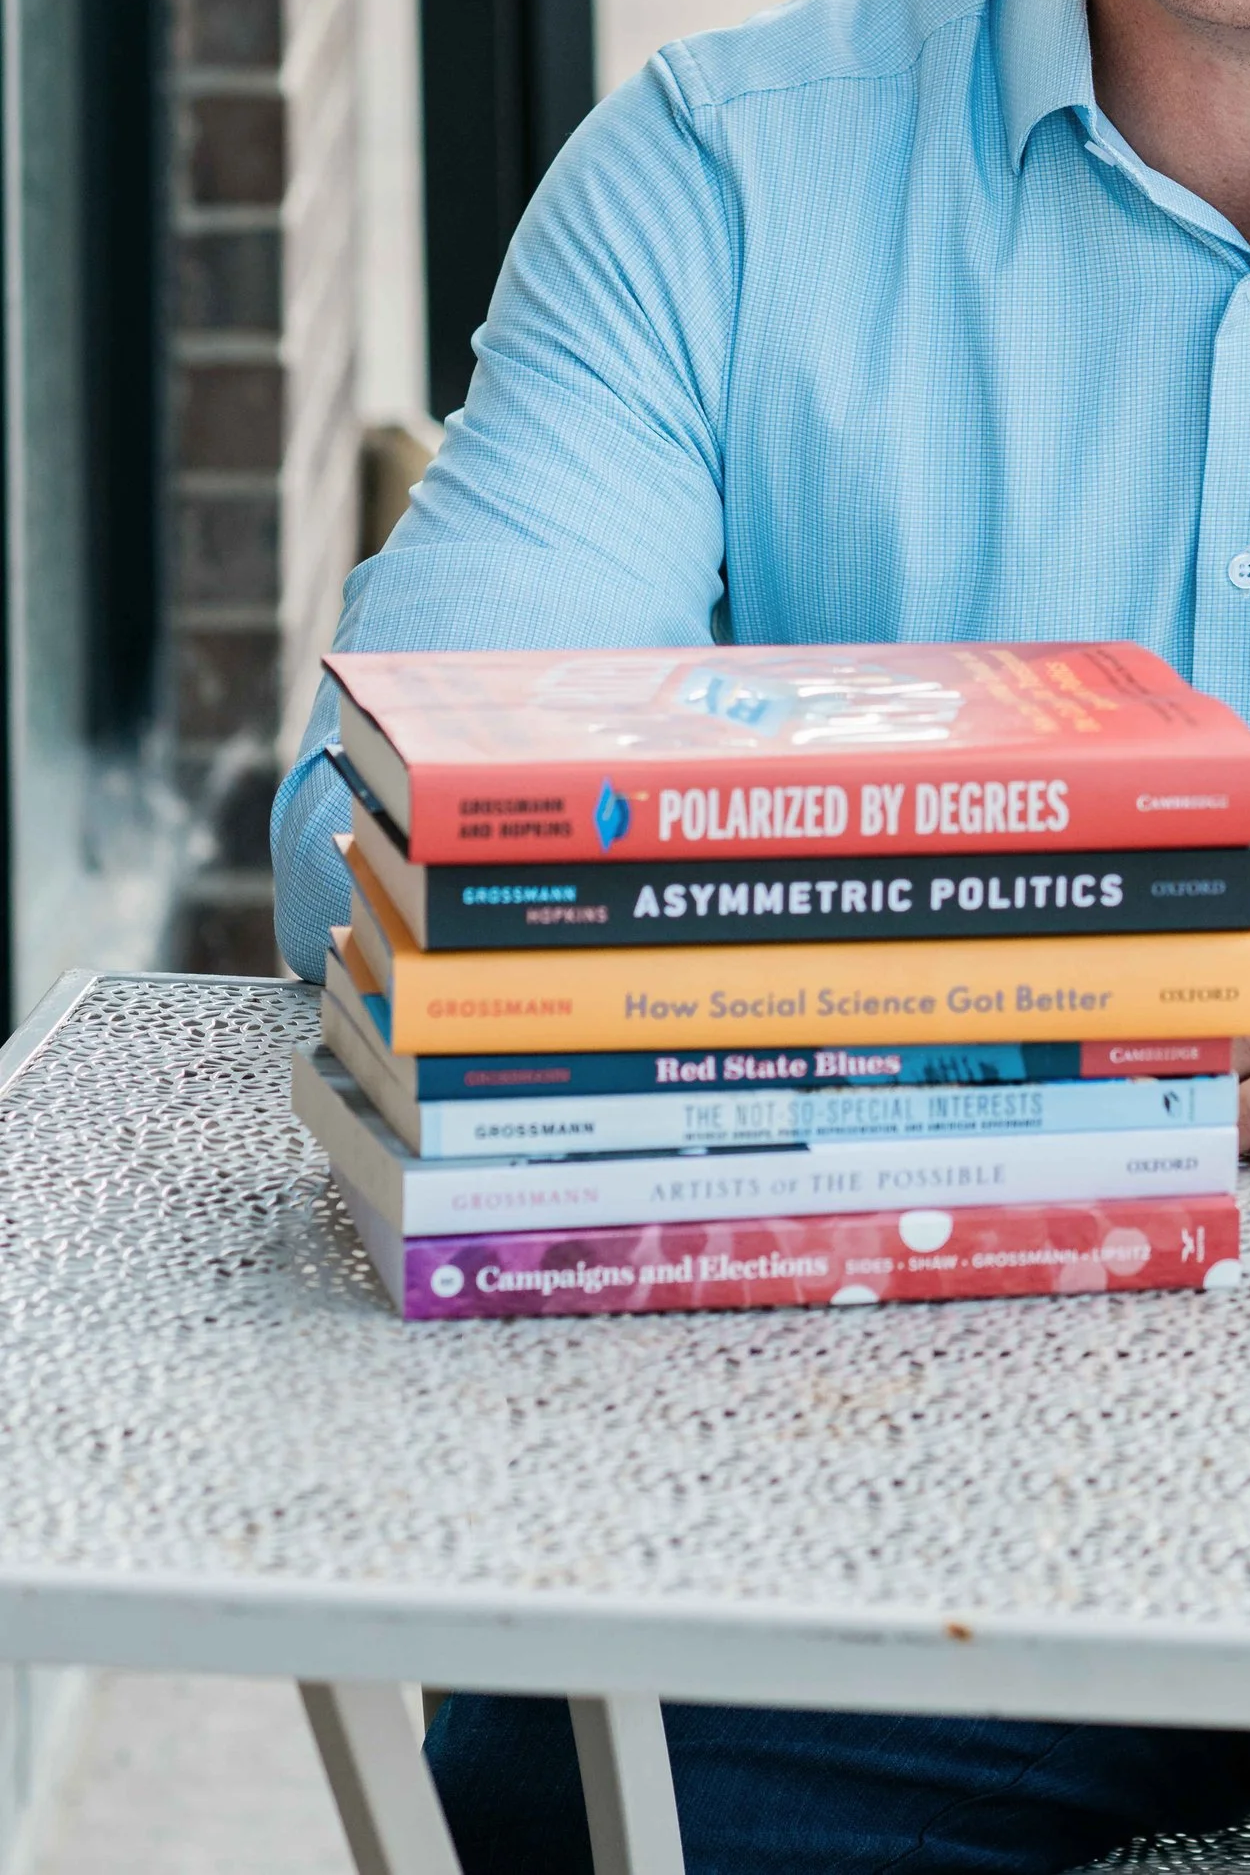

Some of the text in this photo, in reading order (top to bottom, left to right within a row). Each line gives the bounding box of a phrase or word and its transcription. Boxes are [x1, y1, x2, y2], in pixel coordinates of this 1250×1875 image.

[458, 798, 564, 816] GROSSMANN
[659, 780, 1069, 842] POLARIZED BY DEGREES
[458, 821, 572, 839] AND HOPKINS
[462, 886, 577, 905] GROSSMANN
[633, 873, 1124, 918] ASYMMETRIC POLITICS
[1150, 880, 1227, 897] OXFORD
[526, 905, 608, 924] HOPKINS
[625, 983, 1112, 1020] How Social Science Got Better
[1159, 987, 1239, 1003] OXFORD
[427, 999, 573, 1019] GROSSMANN
[656, 1050, 902, 1083] Red State Blues
[685, 1092, 1043, 1126] THE NOT-SO-SPECIAL INTERESTS
[474, 1121, 595, 1139] GROSSMANN
[1126, 1157, 1198, 1174] OXFORD
[651, 1178, 760, 1202] ARTISTS
[811, 1172, 863, 1193] THE
[878, 1164, 1006, 1188] POSSIBLE
[452, 1188, 599, 1211] GROSSMANN
[844, 1244, 1152, 1275] SIDES SHAW GROSSMANN LIPSITZ
[476, 1250, 829, 1295] Campaigns and Elections
